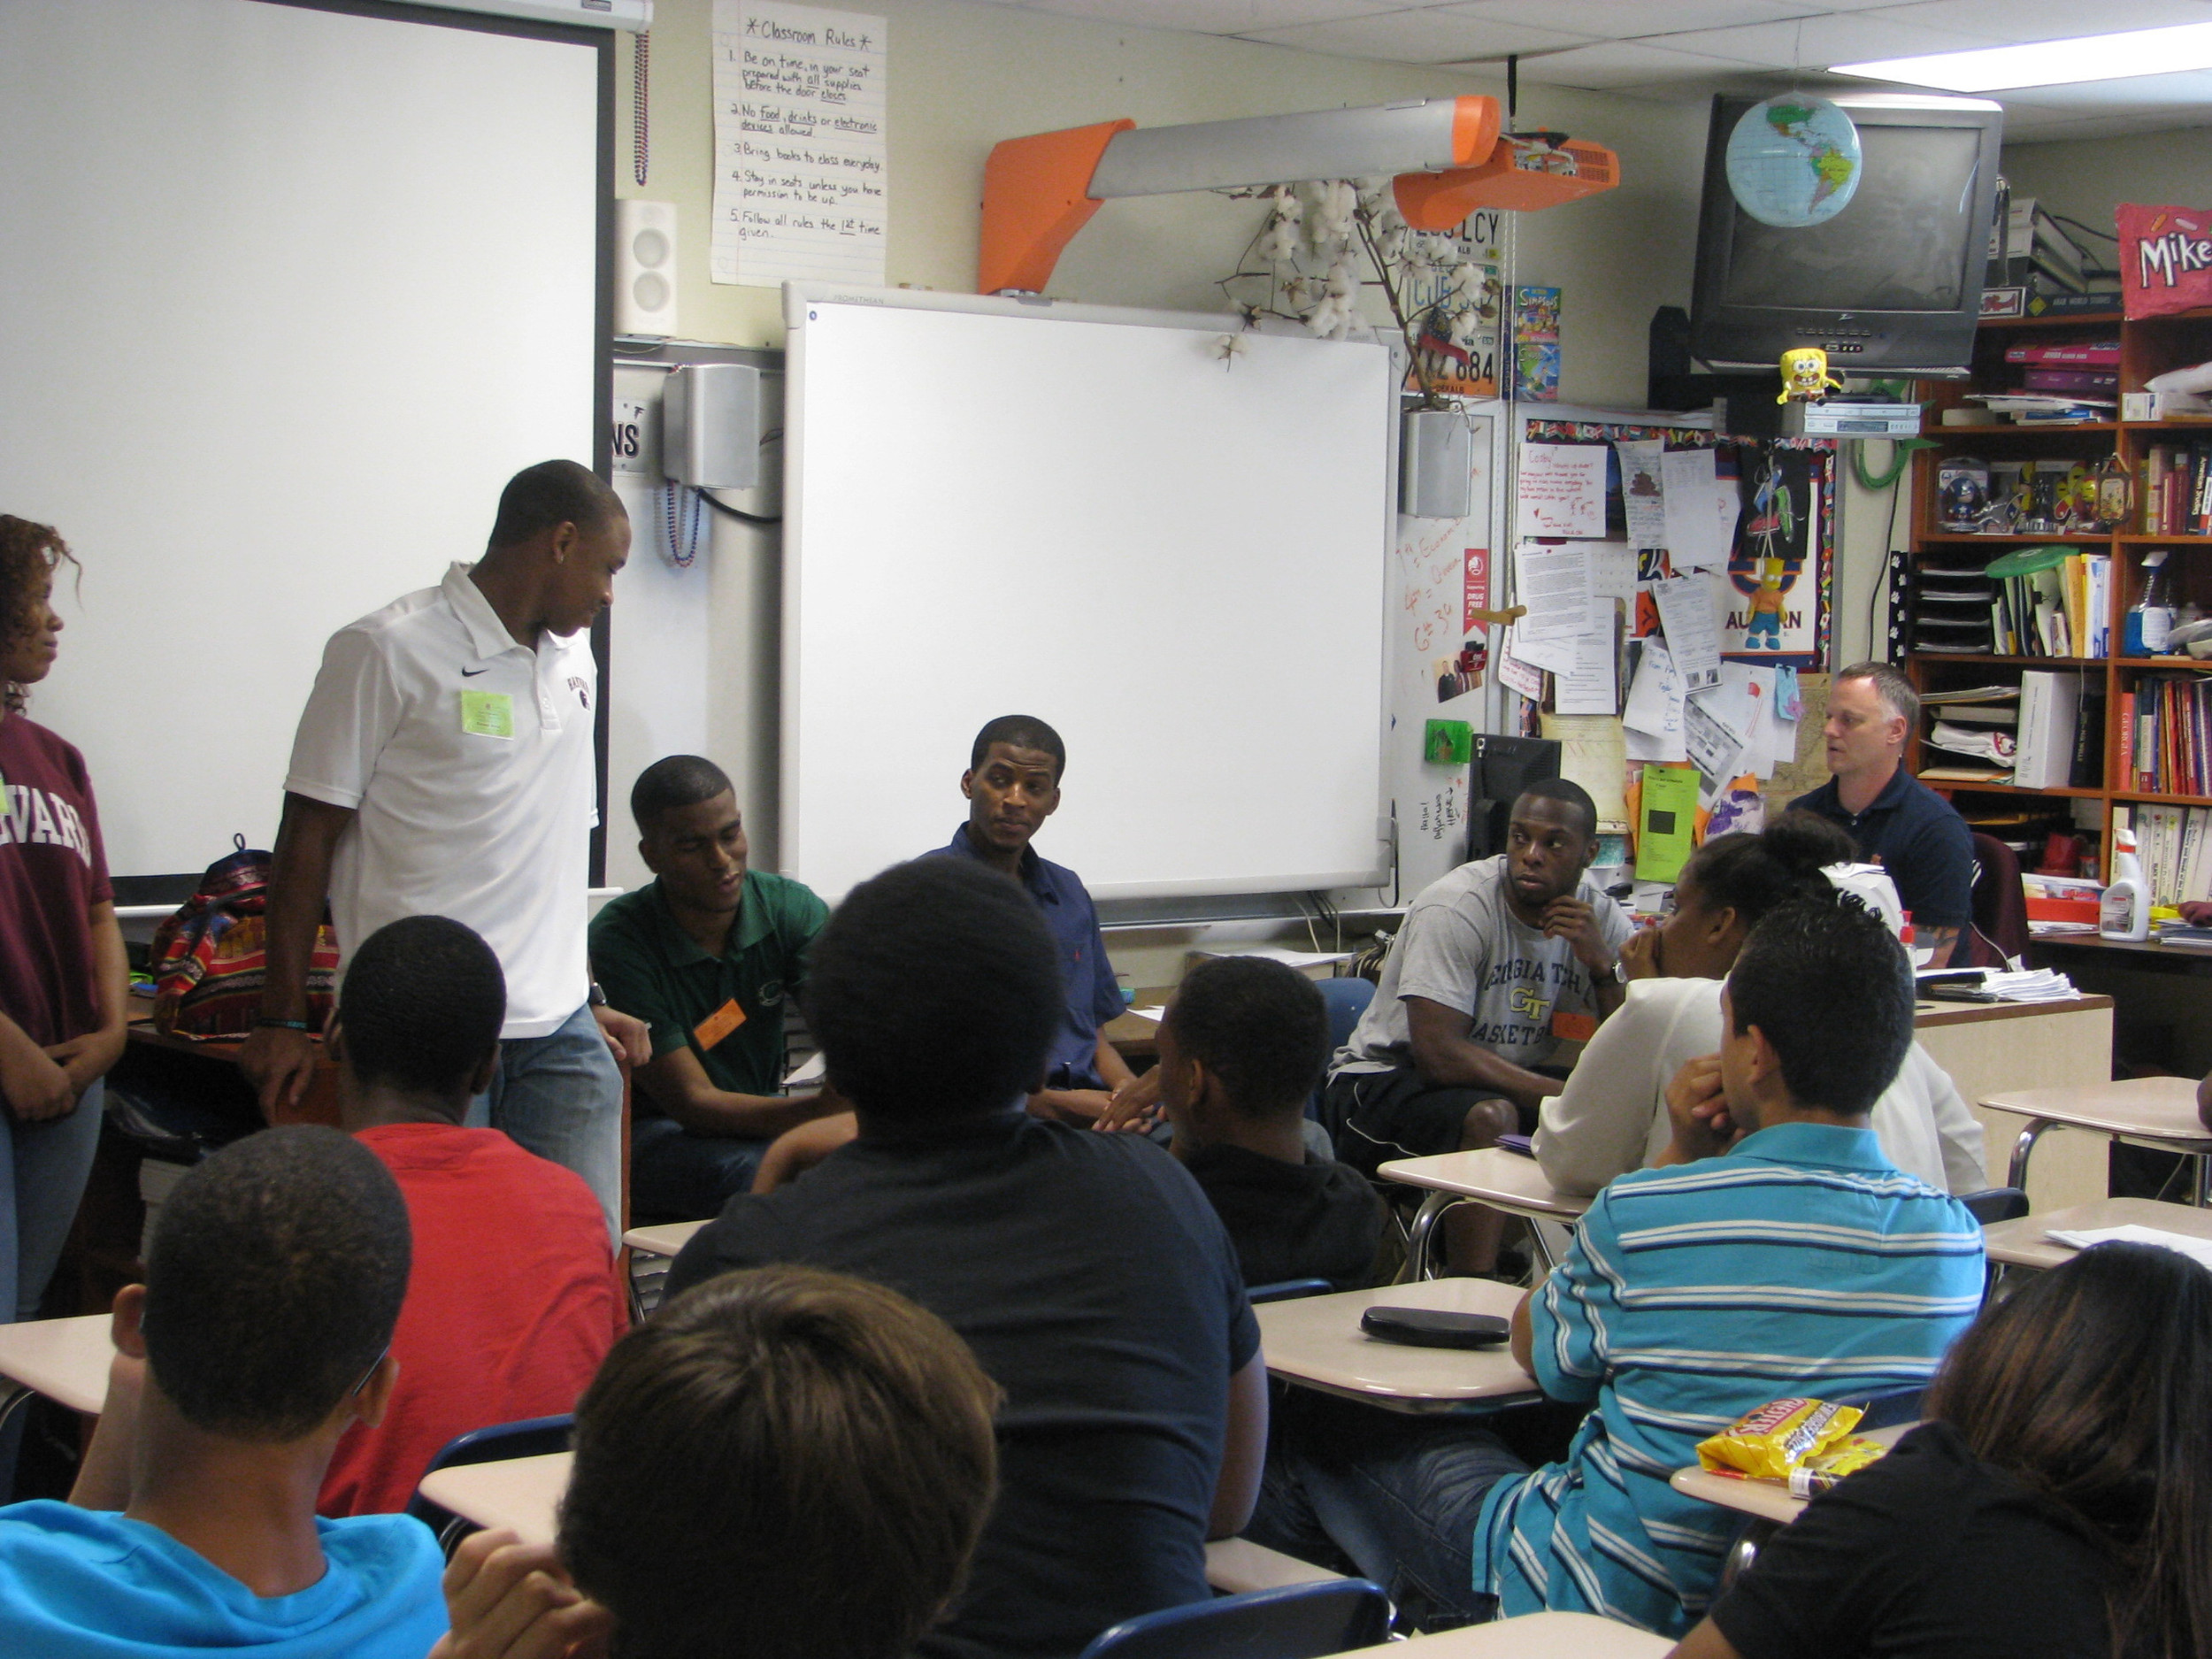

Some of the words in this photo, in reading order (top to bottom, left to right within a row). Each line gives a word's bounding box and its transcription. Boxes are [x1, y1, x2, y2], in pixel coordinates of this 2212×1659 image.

[762, 21, 816, 43] Classroom
[826, 28, 856, 48] Rules
[744, 51, 757, 65] Be
[762, 57, 776, 66] on
[823, 65, 842, 79] your
[849, 65, 870, 78] seat
[742, 68, 780, 85] prepared
[783, 73, 802, 82] with
[807, 74, 819, 87] all
[824, 79, 862, 91] supplies
[745, 80, 772, 92] before
[777, 83, 792, 96] the
[795, 86, 816, 97] door
[821, 89, 846, 102] closes
[741, 119, 773, 133] devices
[742, 104, 756, 118] No
[788, 111, 817, 125] drinks
[820, 117, 832, 126] or
[834, 117, 877, 133] electronic
[743, 142, 771, 161] Bring
[777, 147, 802, 161] books
[804, 150, 815, 164] to
[818, 154, 839, 165] class
[743, 188, 789, 200] permission
[794, 192, 803, 202] to
[808, 192, 818, 203] be
[744, 171, 764, 187] Stay
[768, 176, 777, 185] in
[781, 175, 803, 188] seats
[809, 179, 837, 191] unless
[841, 186, 858, 197] you
[863, 183, 882, 196] have
[742, 211, 771, 225] Follow
[775, 213, 787, 227] all
[793, 215, 814, 228] rules
[820, 219, 836, 231] the
[858, 220, 880, 234] time
[2139, 232, 2212, 288] Mike
[2120, 713, 2129, 756] GEORGIA
[1509, 987, 1551, 1020] GT
